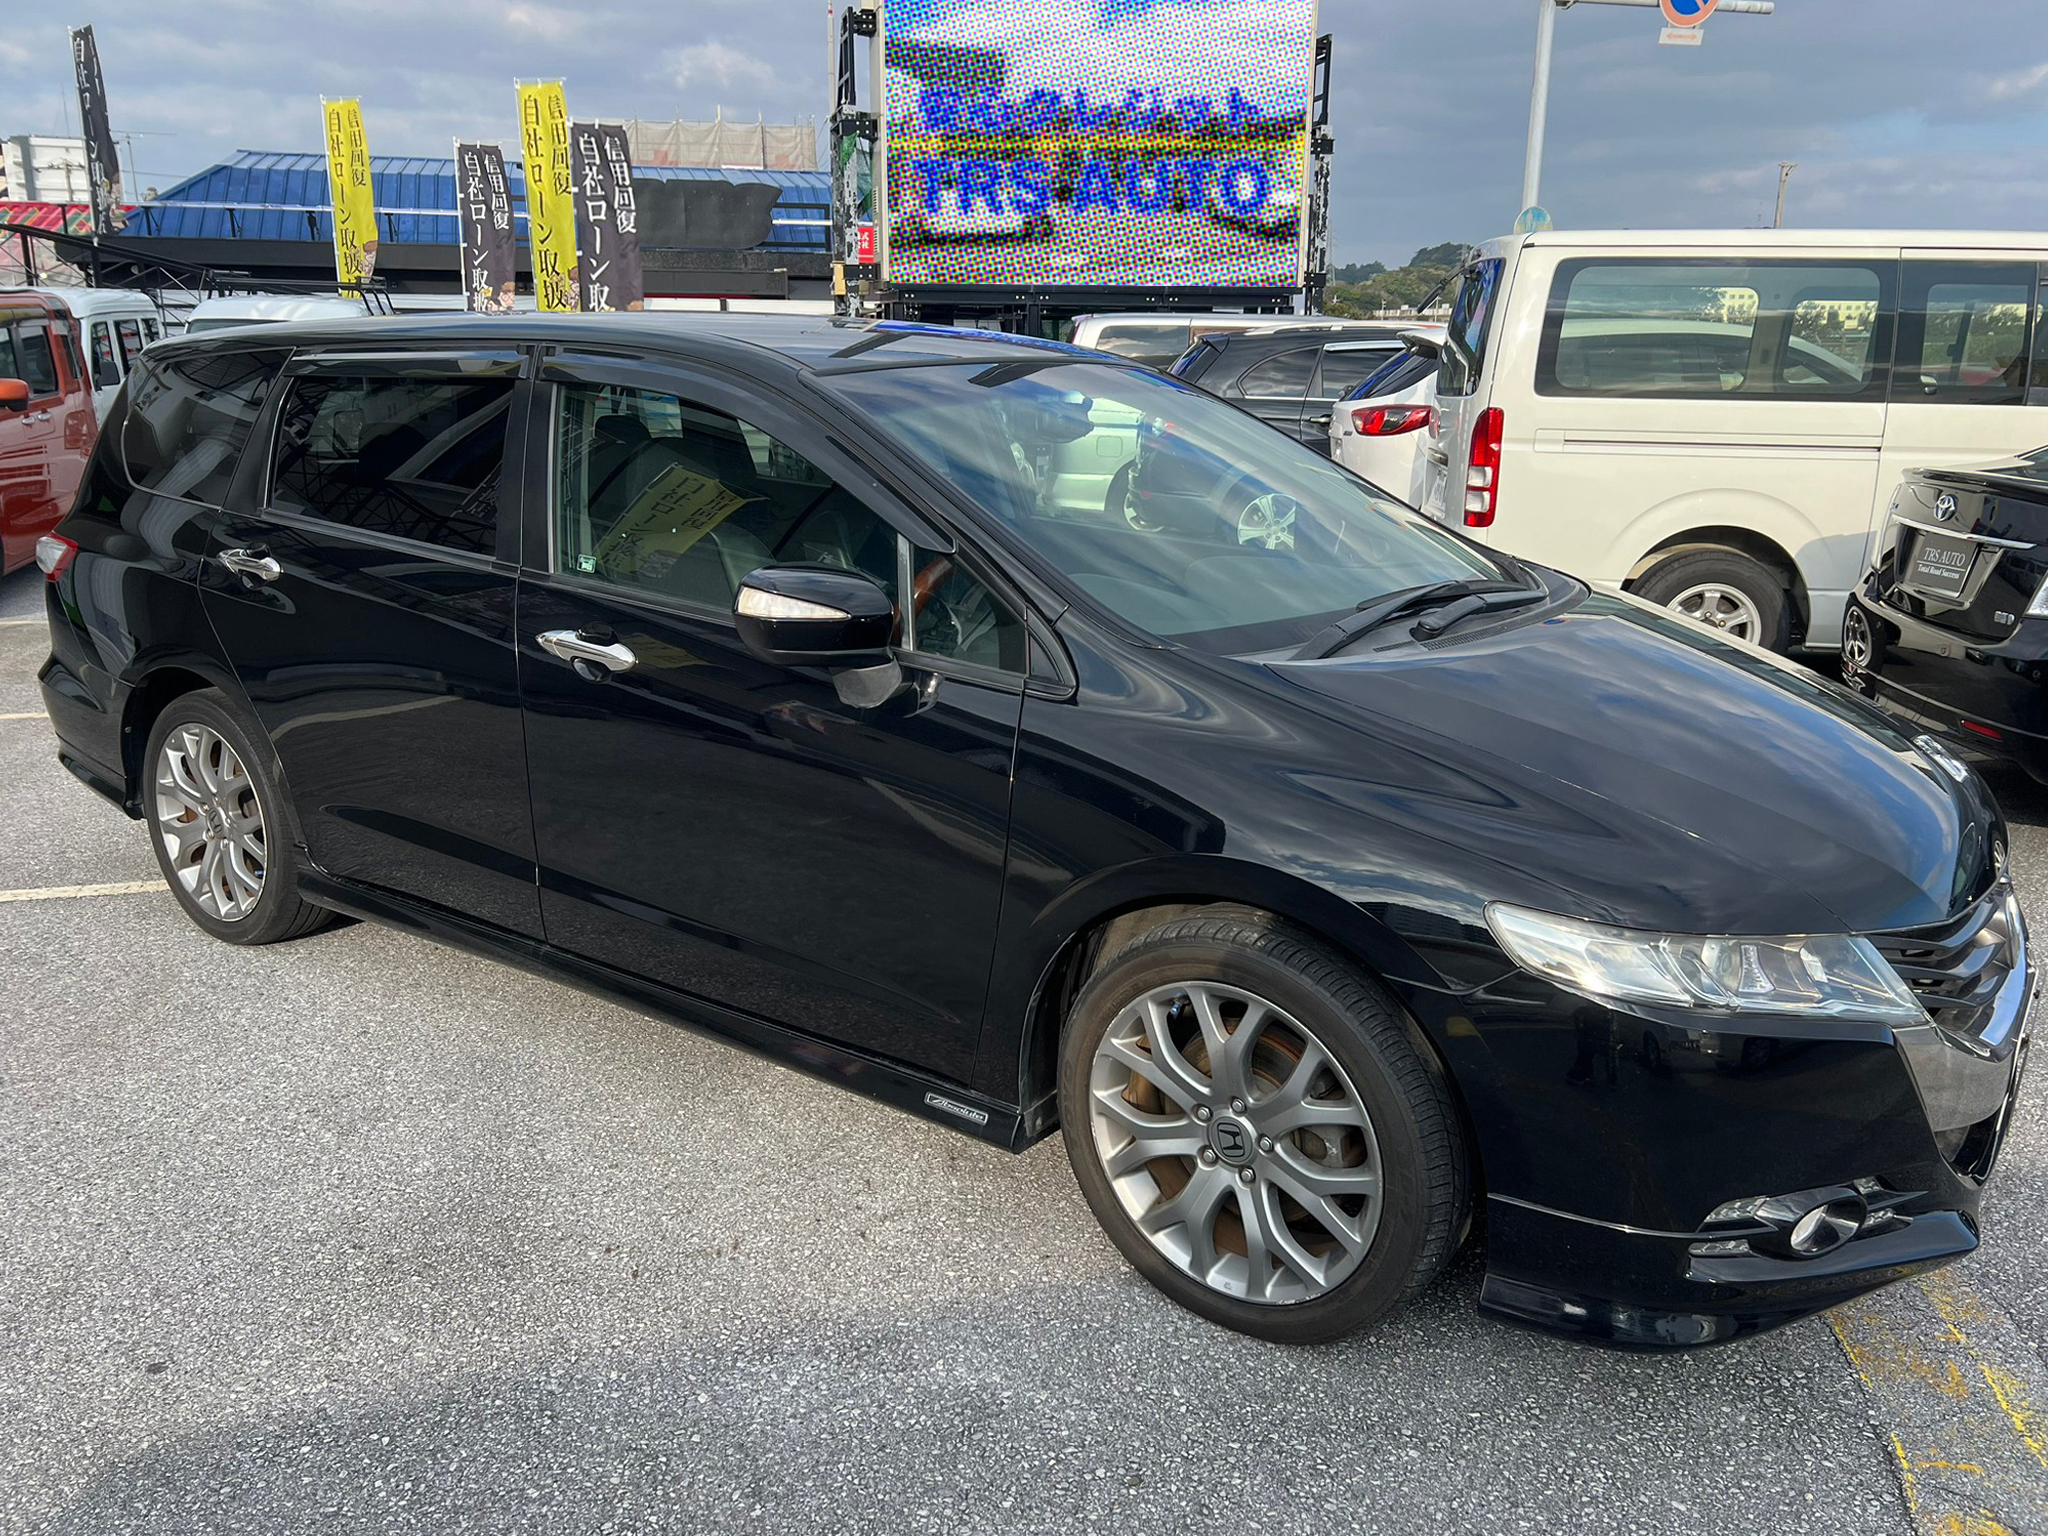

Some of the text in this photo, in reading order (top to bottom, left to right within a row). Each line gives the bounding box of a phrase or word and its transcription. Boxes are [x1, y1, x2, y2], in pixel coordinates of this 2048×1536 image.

[347, 108, 367, 187] 信用回復
[604, 136, 637, 235] 信用回復
[909, 158, 1272, 215] TRS AUTO
[483, 153, 510, 231] 信用回復
[1923, 547, 1965, 566] TRS AUTO
